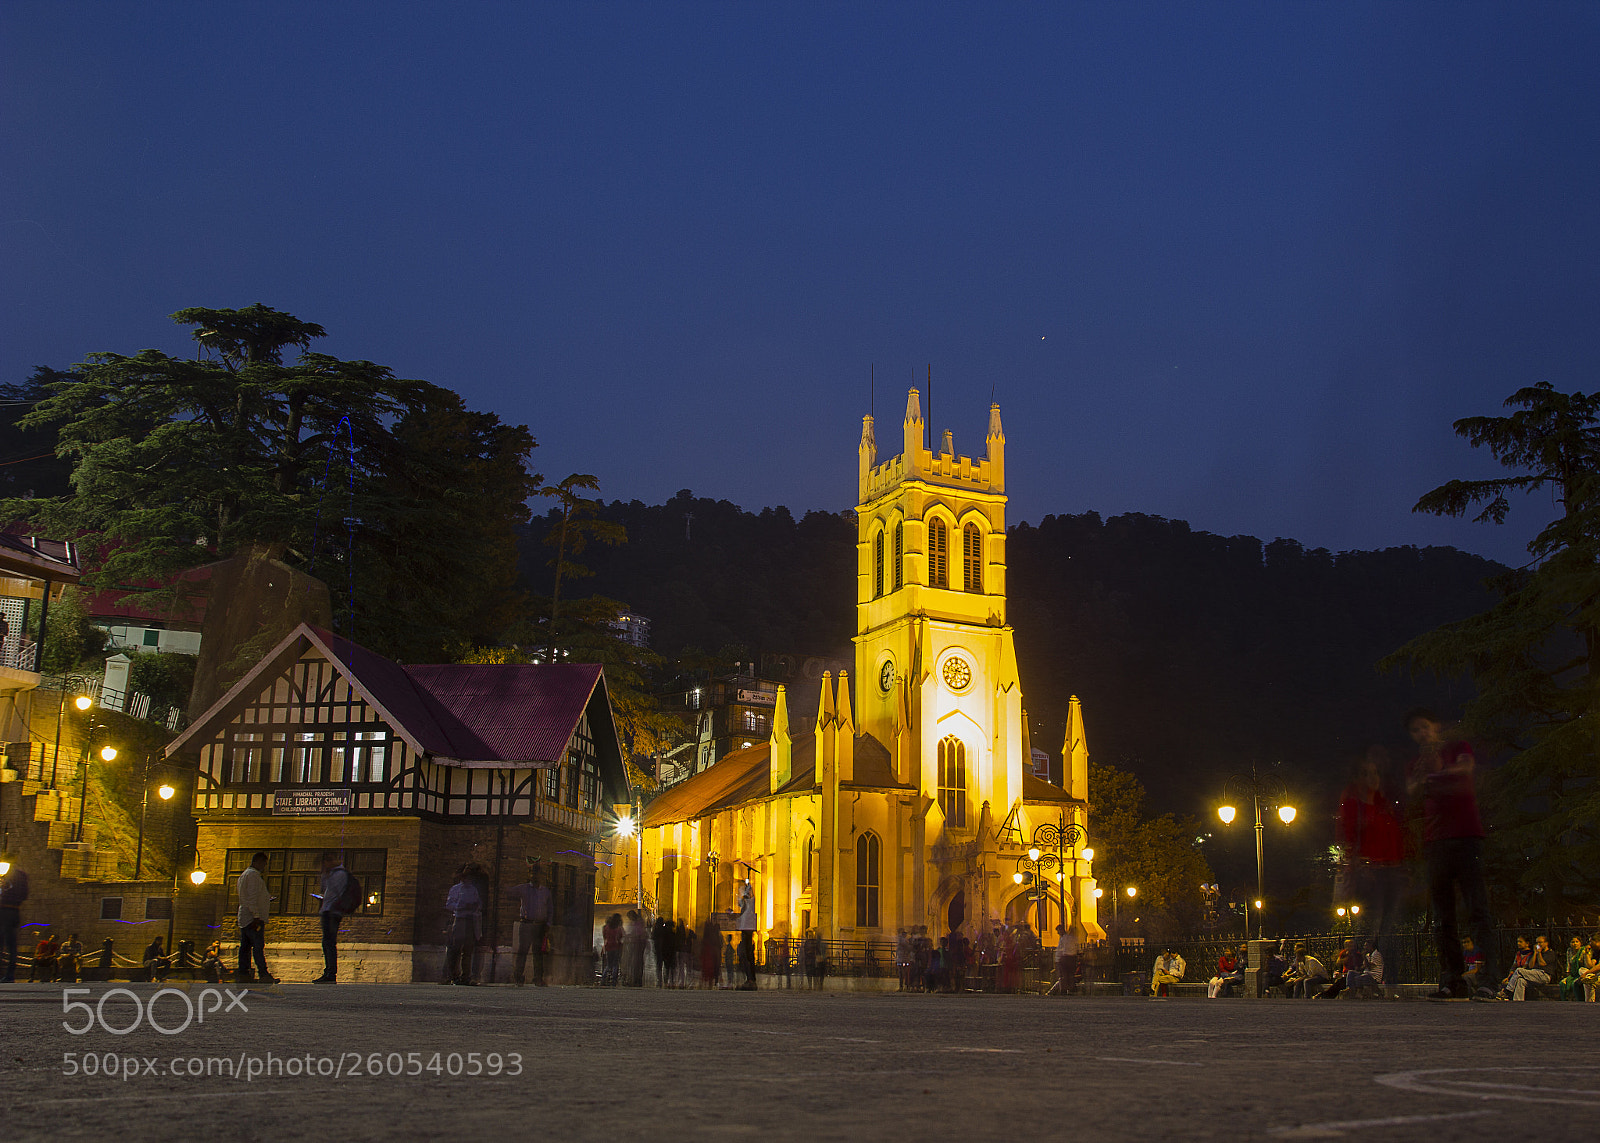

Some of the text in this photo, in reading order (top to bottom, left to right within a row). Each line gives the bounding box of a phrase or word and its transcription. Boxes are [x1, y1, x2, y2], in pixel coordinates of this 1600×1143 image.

[275, 797, 348, 806] STATE LIBRARY SHIMLA
